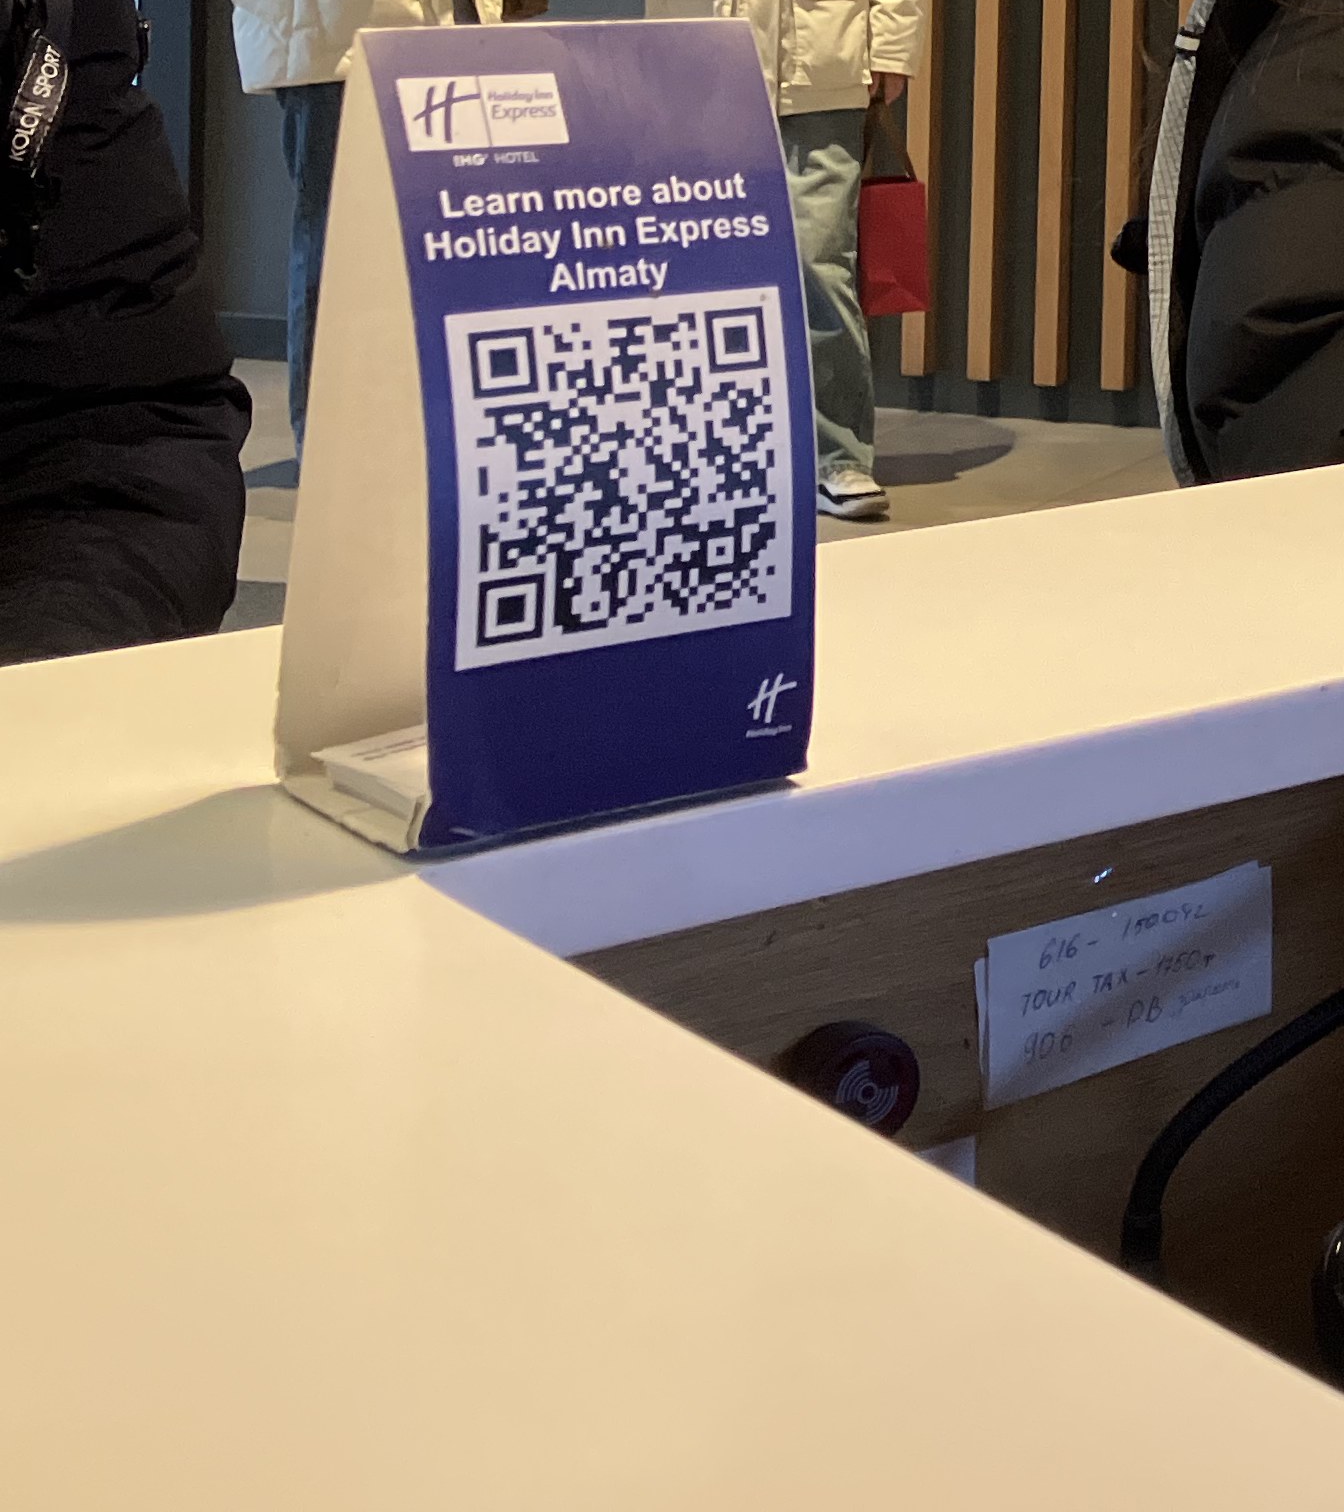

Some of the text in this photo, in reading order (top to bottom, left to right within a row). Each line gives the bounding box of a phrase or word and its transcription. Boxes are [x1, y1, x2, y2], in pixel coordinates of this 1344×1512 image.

[9, 44, 61, 162] KOLON SPORT
[492, 103, 557, 122] Express
[494, 151, 540, 164] HOTEL
[439, 172, 747, 219] Learn more about
[424, 214, 770, 262] Holiday Inn Express
[550, 258, 668, 293] Almaty
[1038, 932, 1079, 970] 616
[1020, 967, 1129, 1018] TOUR TAX
